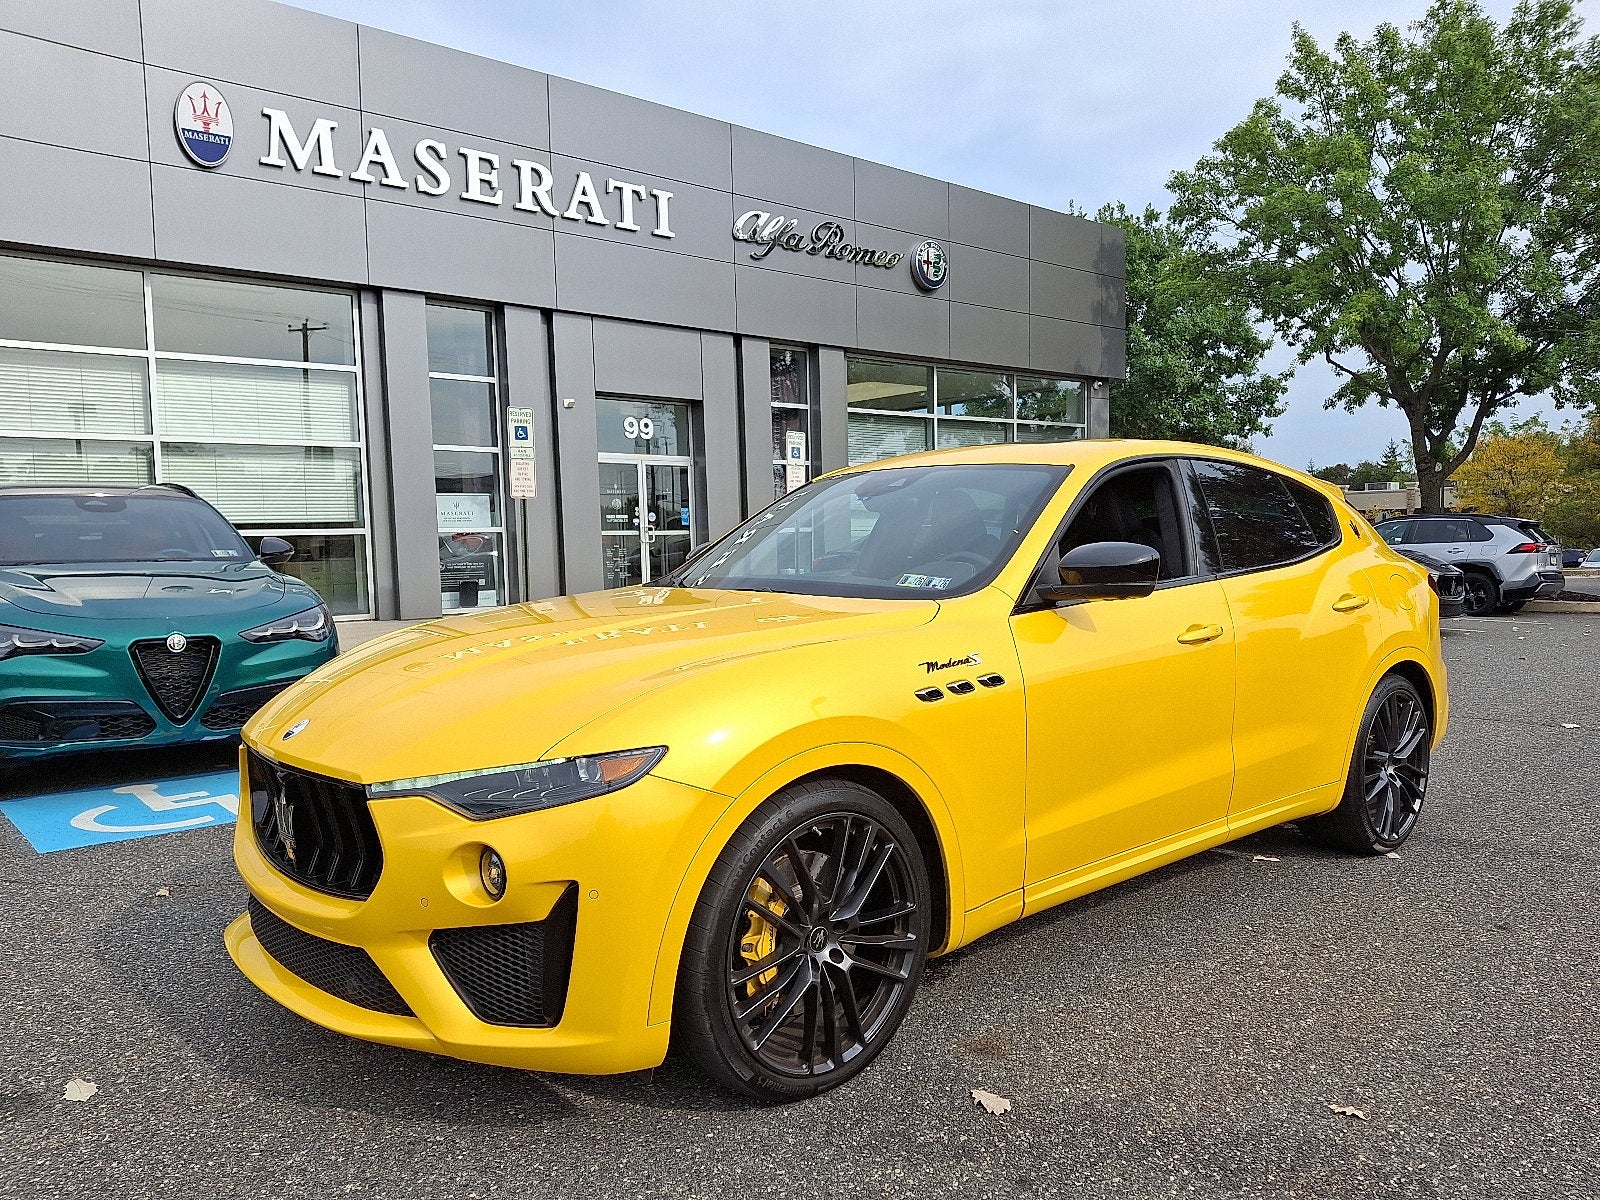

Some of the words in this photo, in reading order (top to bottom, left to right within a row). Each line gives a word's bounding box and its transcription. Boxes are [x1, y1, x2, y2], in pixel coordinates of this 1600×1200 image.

[183, 130, 229, 146] MASERATI
[259, 107, 676, 238] MASERATI
[732, 210, 809, 259] Alfa
[807, 221, 905, 269] Romeo
[623, 416, 654, 440] 99
[918, 656, 972, 674] Modena
